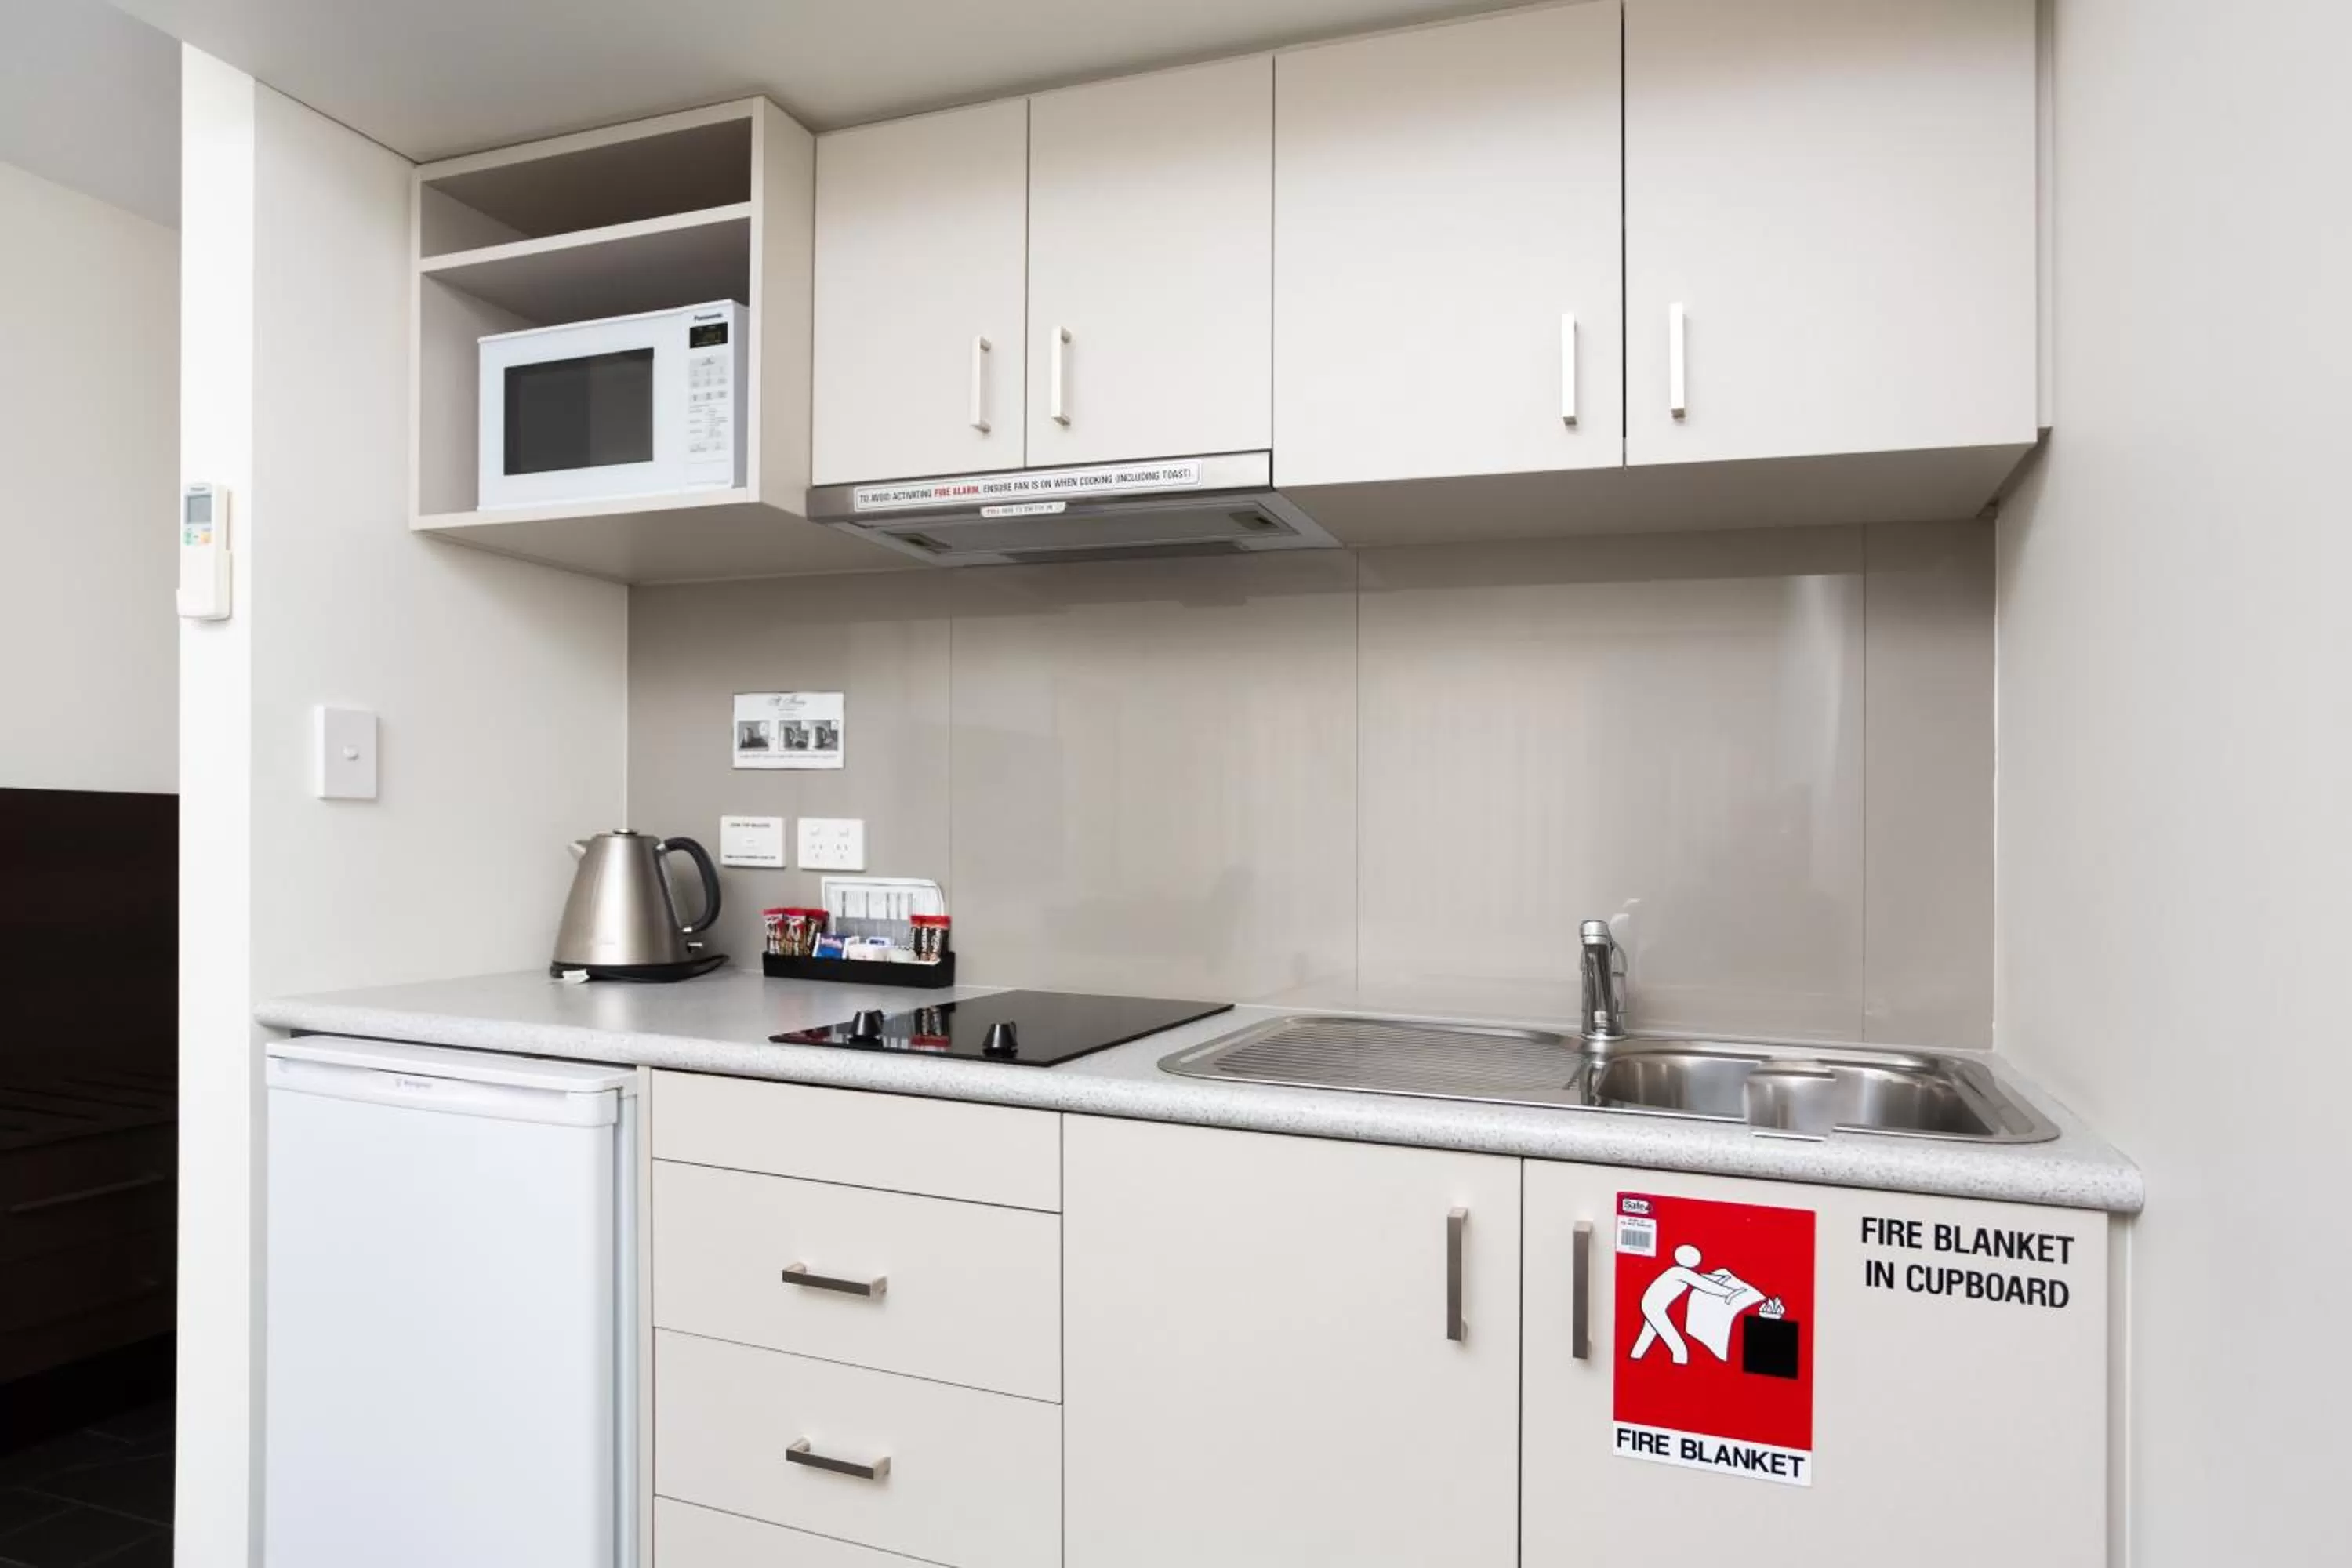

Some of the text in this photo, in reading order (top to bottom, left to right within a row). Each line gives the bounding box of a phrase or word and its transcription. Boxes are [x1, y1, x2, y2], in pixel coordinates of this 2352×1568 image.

[859, 494, 869, 503] TO
[871, 492, 891, 503] AVOID
[934, 488, 951, 498] FIRE
[982, 482, 1012, 493] ENSURE
[1014, 481, 1029, 491] FAN
[1031, 480, 1039, 489] IS
[1040, 479, 1051, 488] ON
[1053, 477, 1078, 488] WHEN
[1080, 474, 1112, 485] COOKING
[1861, 1216, 2075, 1265] FIRE BLANKET
[1865, 1259, 2070, 1308] IN CUPBOARD
[1617, 1427, 1806, 1478] FIRE BLANKET
